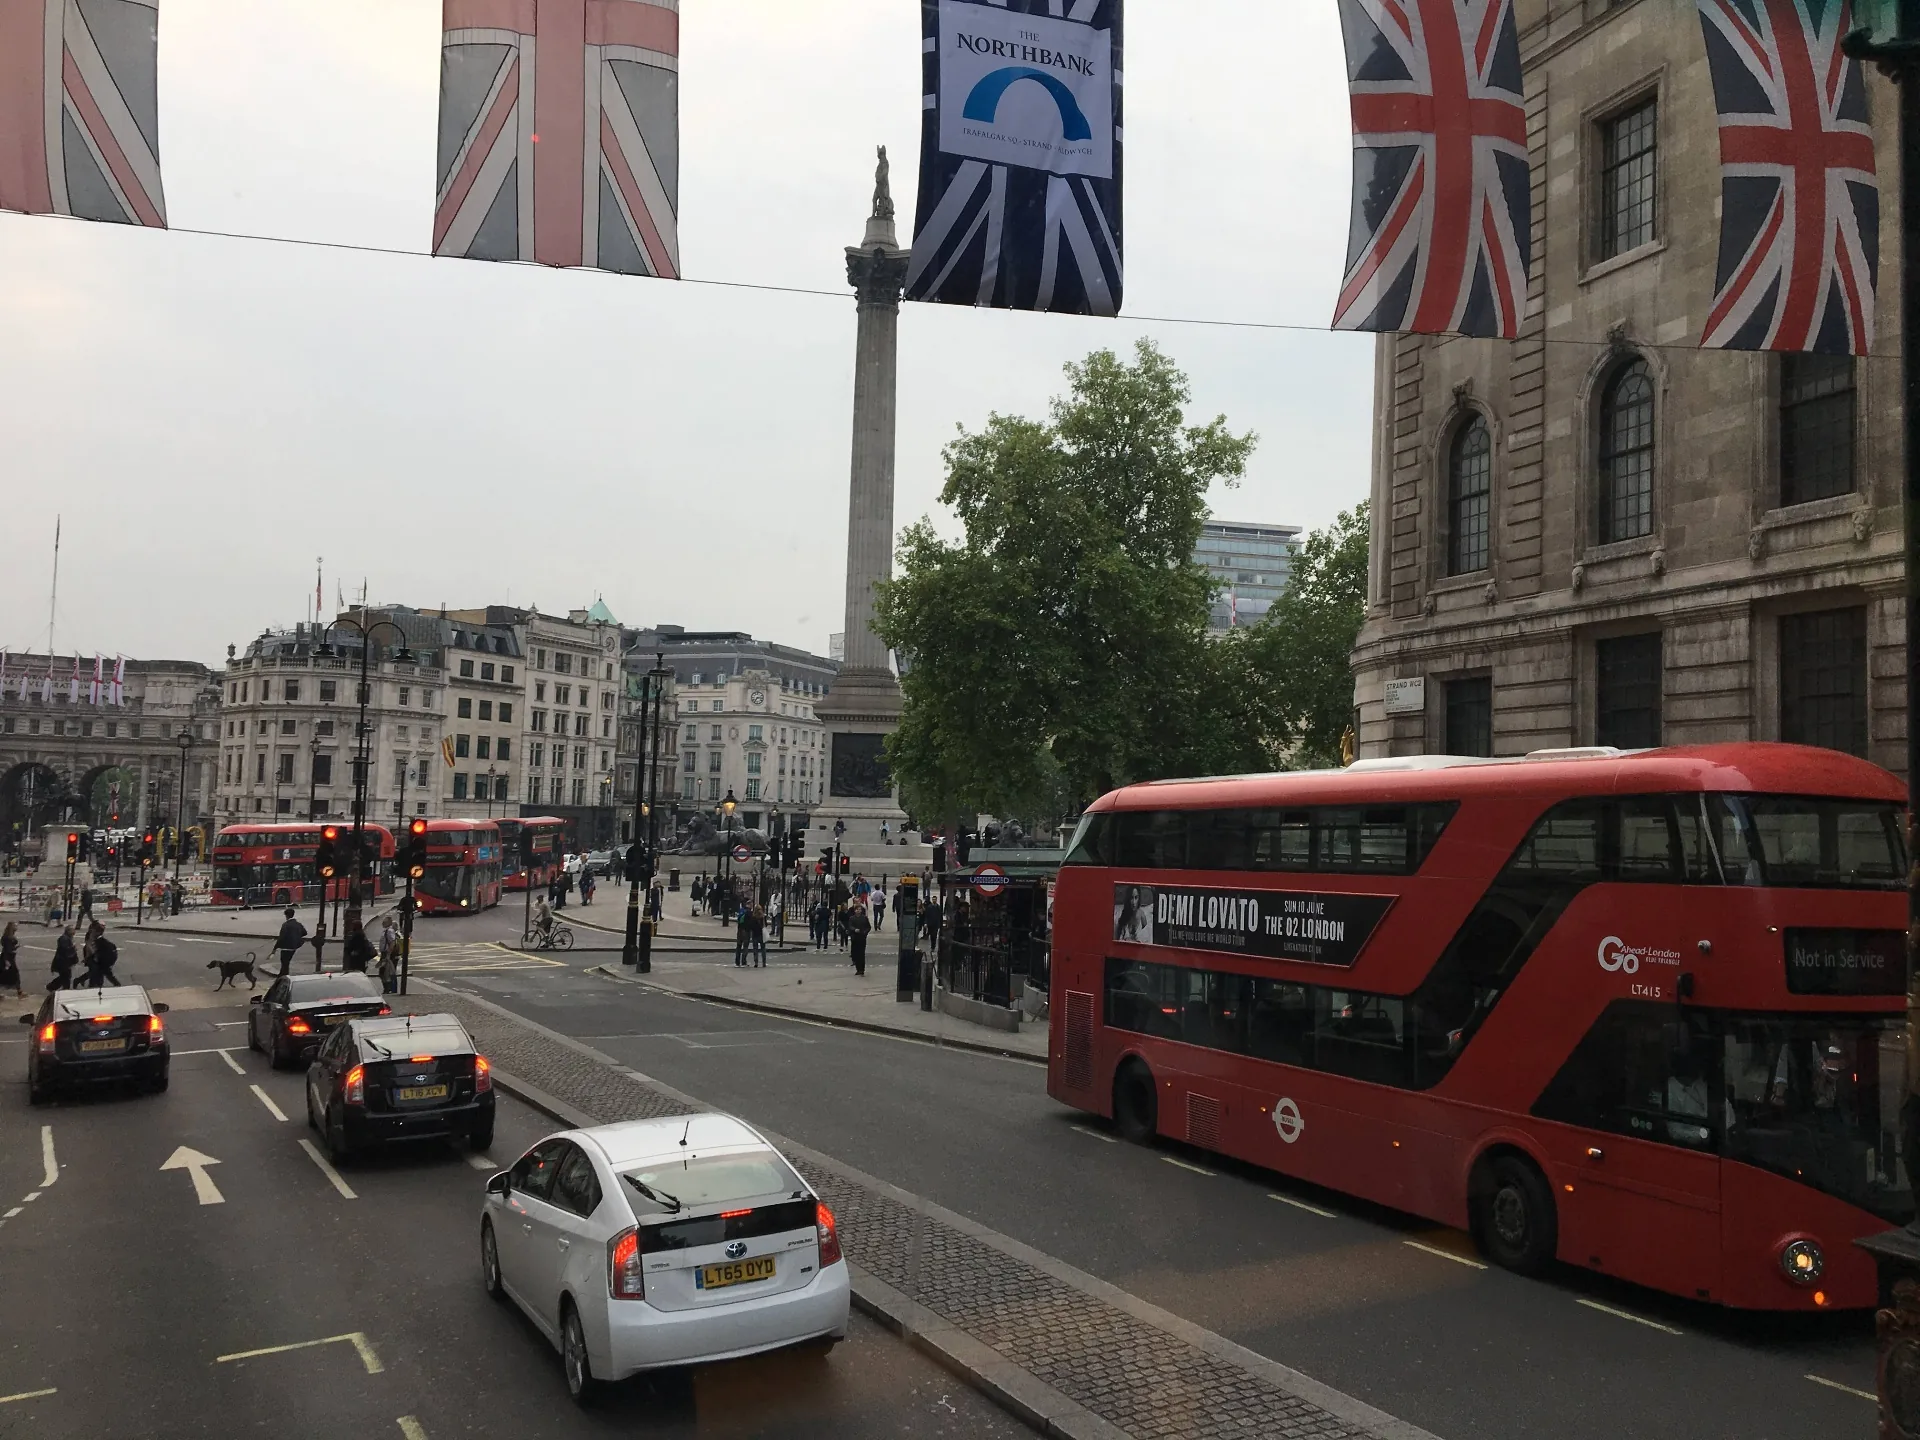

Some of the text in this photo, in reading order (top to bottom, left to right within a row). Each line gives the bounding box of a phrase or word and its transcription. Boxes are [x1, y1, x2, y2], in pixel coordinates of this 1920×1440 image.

[1018, 29, 1040, 42] THE
[956, 32, 1096, 77] NORTHBANK
[963, 127, 1093, 156] TRAFALGAR SQ STRAND ALDWYCH
[1386, 679, 1422, 690] STRAND WC2
[1157, 893, 1259, 932] DEMI LOVATO
[1284, 900, 1325, 915] SUN 10 JUNE
[1264, 915, 1284, 936] THE
[1301, 918, 1344, 941] LONDON
[1597, 935, 1681, 974] Go Ahead-London
[1794, 947, 1885, 969] Not in Service
[1631, 983, 1661, 998] LT415
[704, 1258, 773, 1285] LT65 OYD
